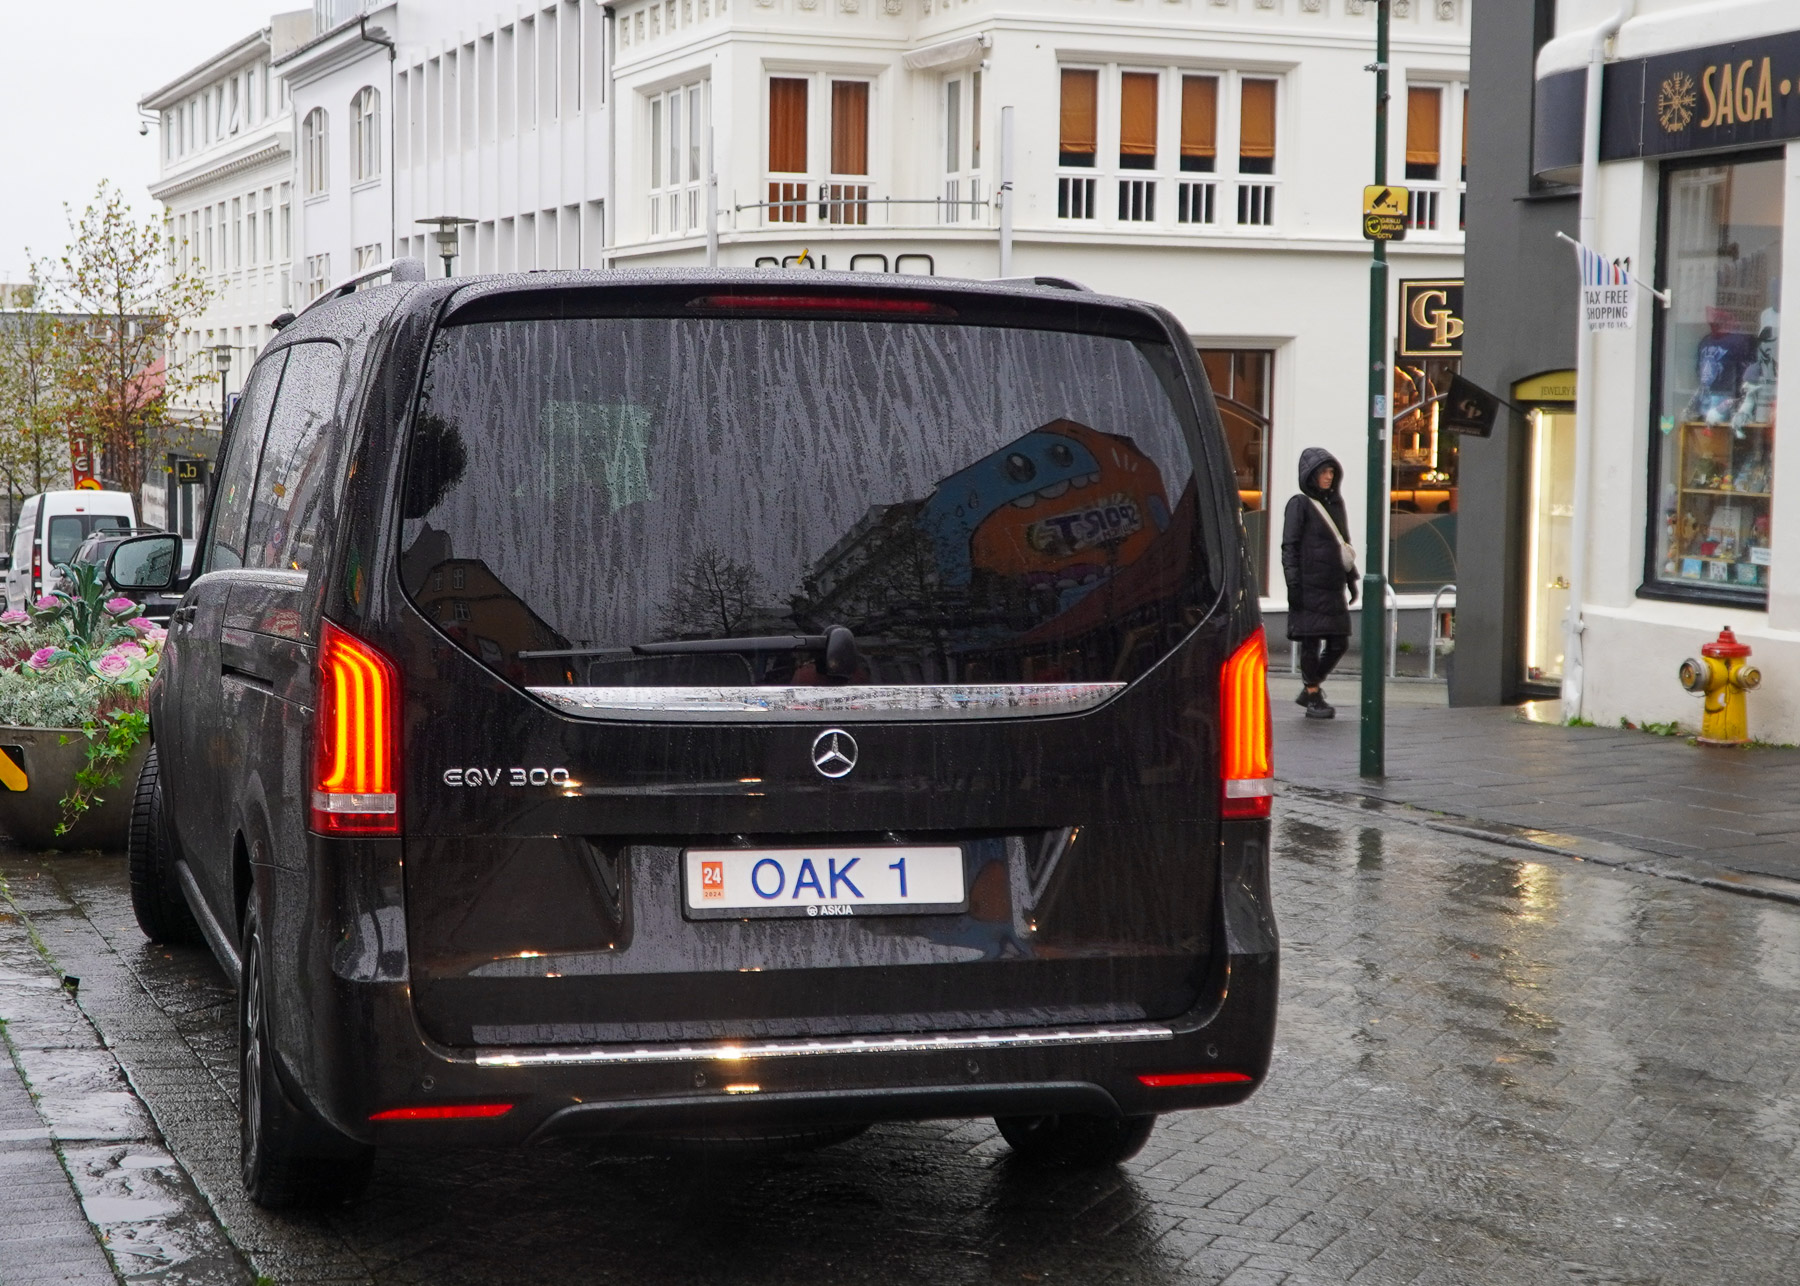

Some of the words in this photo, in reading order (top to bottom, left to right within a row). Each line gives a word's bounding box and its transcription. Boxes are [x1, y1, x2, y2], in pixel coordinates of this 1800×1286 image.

[1700, 57, 1773, 128] SAGA
[1585, 291, 1601, 305] TAX
[1605, 290, 1628, 304] FREE
[1587, 306, 1628, 320] SHOPPING
[1541, 386, 1570, 396] JEWELRY
[443, 768, 501, 787] EQV
[509, 768, 570, 787] 300
[704, 867, 722, 884] 24
[751, 857, 864, 900] OAK
[889, 857, 908, 898] 1
[821, 904, 854, 916] ASKJA
